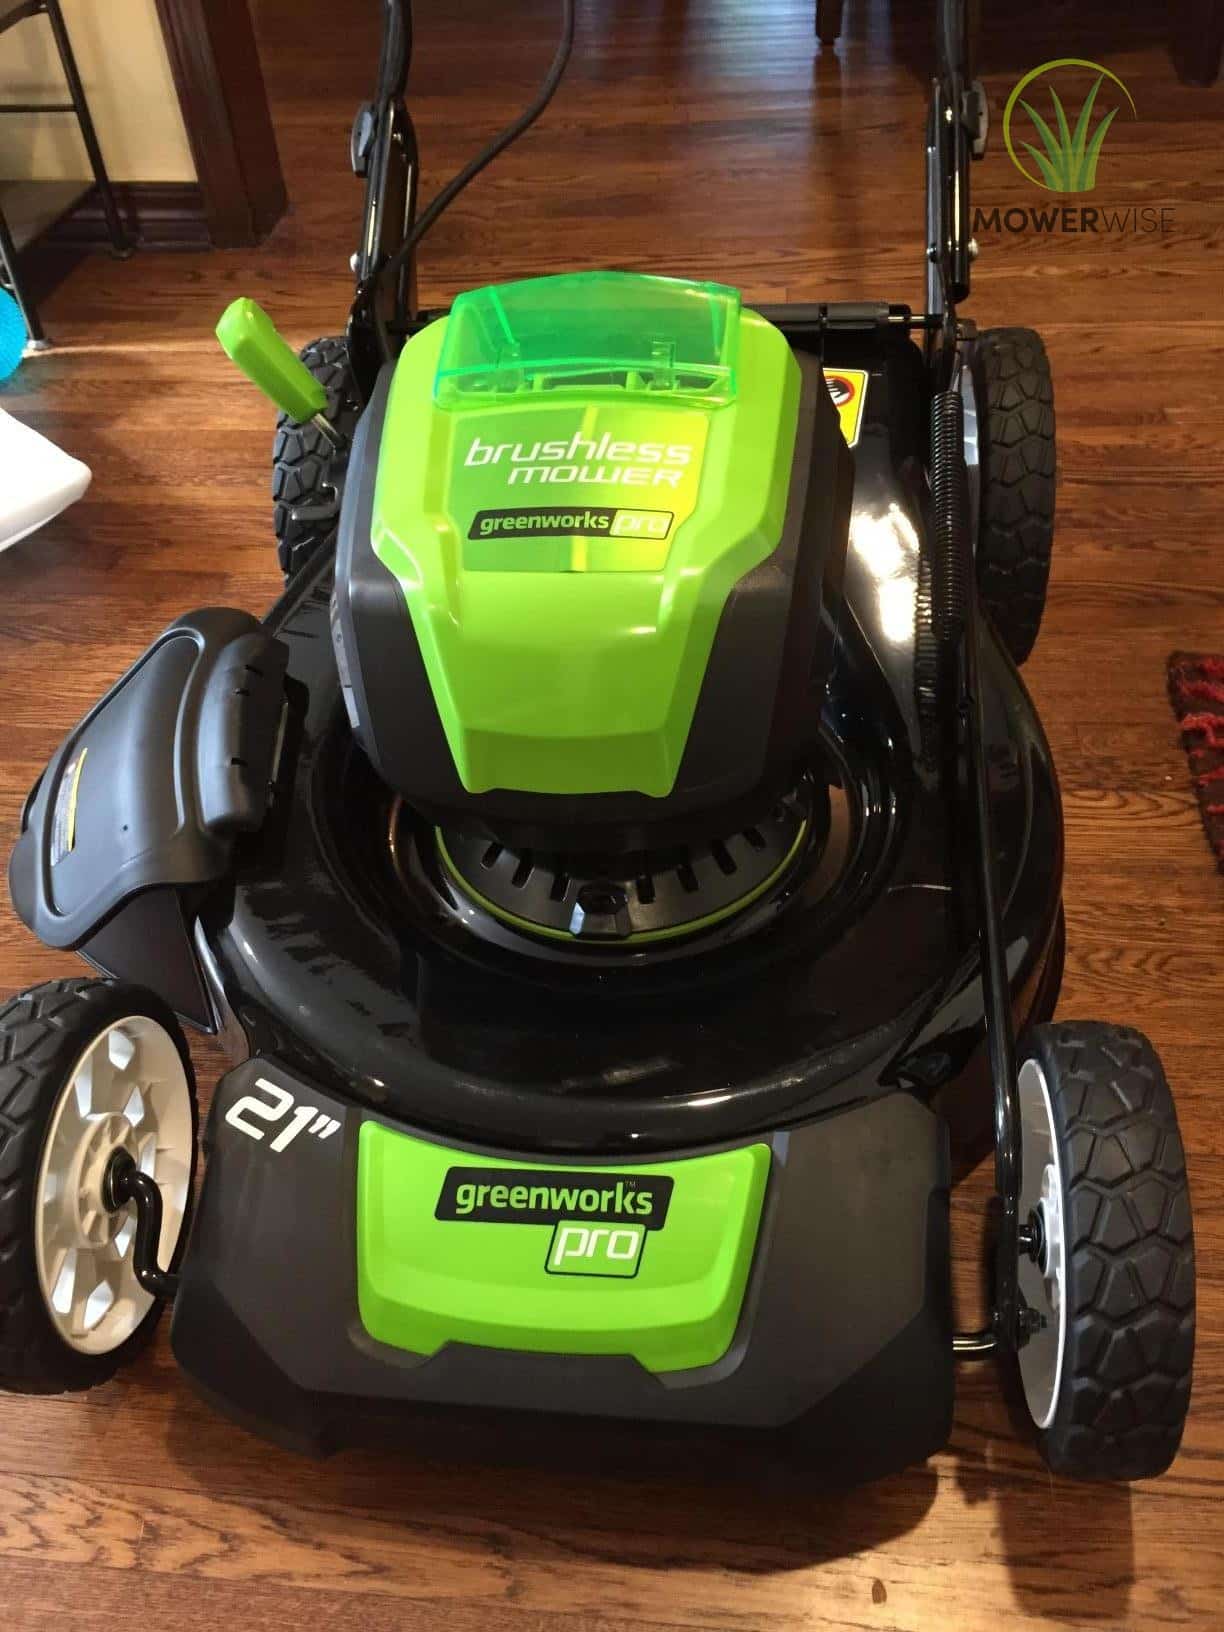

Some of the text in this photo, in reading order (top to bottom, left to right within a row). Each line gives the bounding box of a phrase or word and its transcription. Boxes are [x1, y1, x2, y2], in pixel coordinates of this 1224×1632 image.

[464, 431, 693, 467] brushless
[480, 511, 670, 536] greenworks pro
[455, 1181, 653, 1215] greenworks
[554, 1227, 640, 1266] pro
